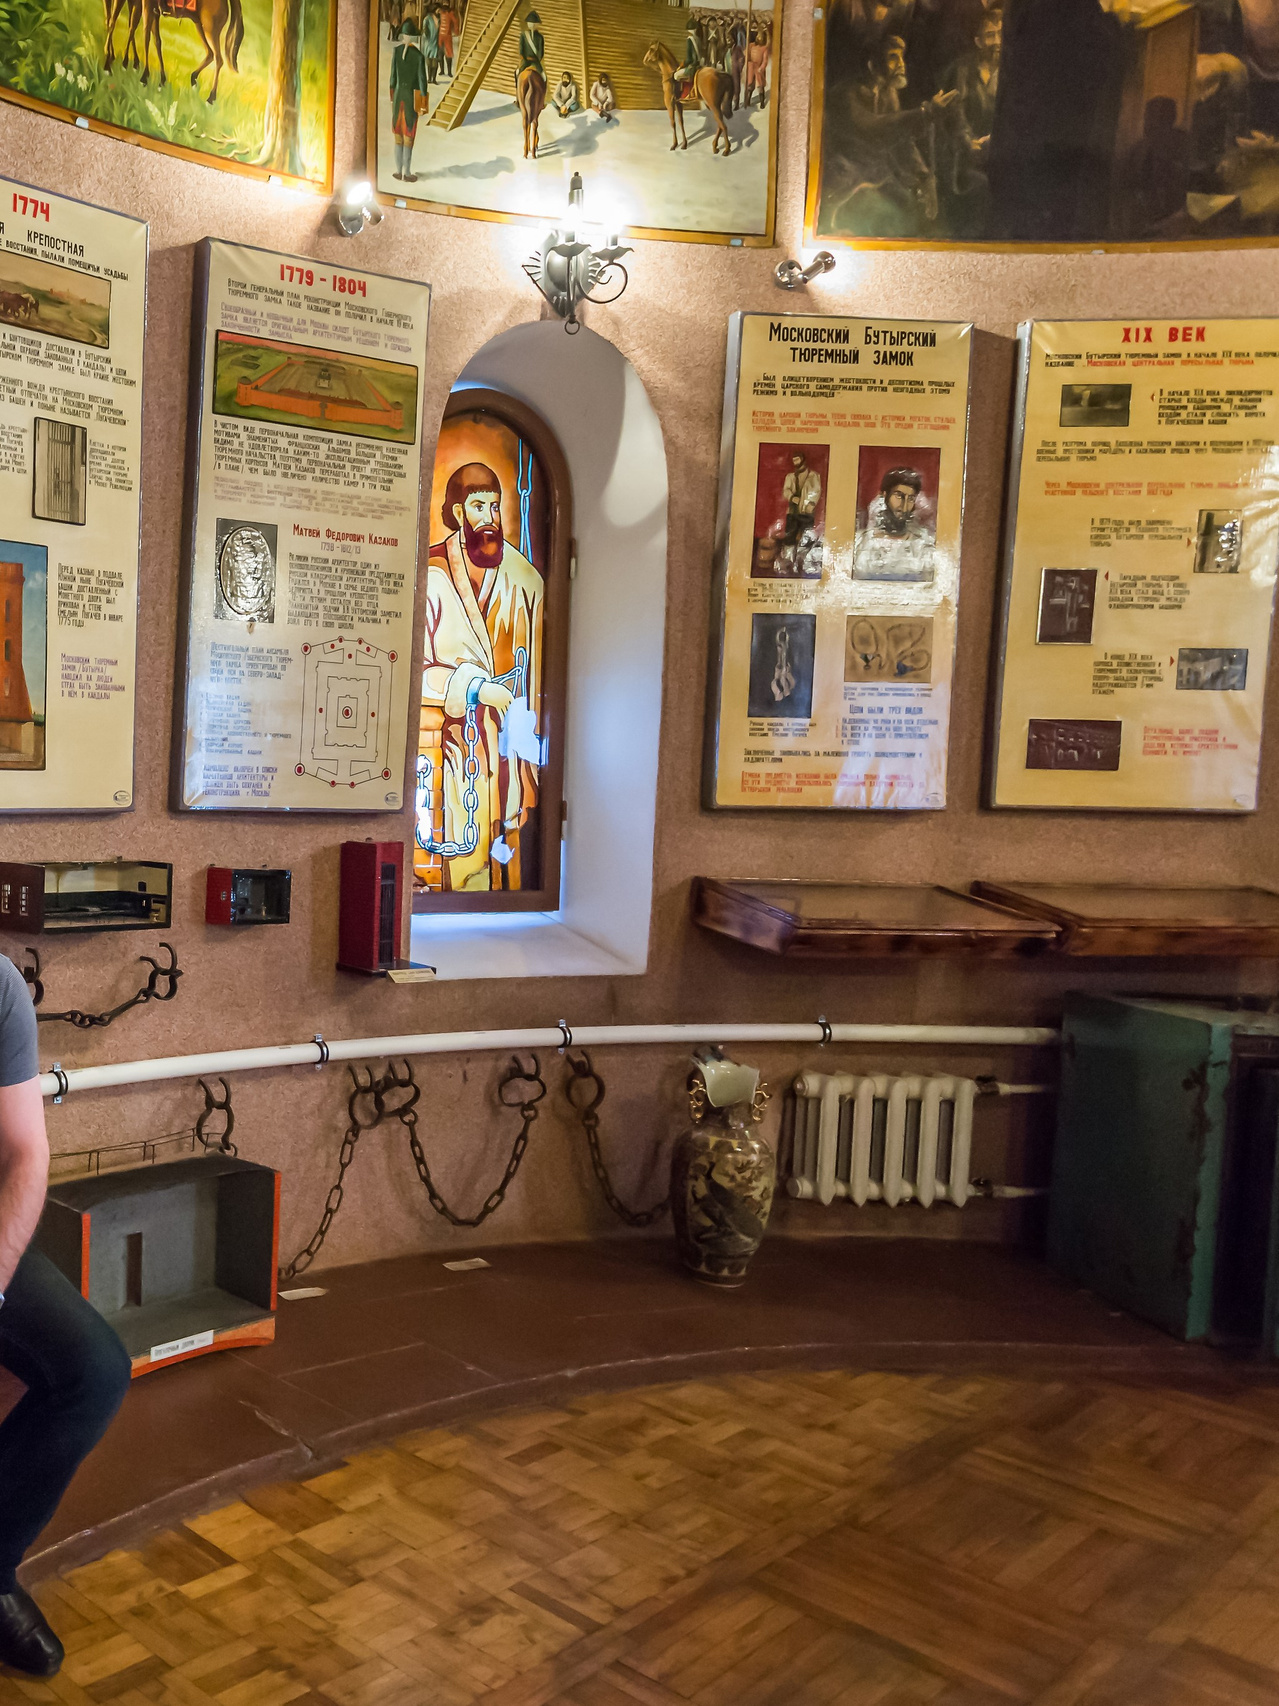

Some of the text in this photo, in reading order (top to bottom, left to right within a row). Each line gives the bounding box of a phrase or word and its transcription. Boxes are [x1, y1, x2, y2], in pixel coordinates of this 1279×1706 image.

[12, 193, 50, 222] 1774
[27, 228, 84, 258] КРЕПОСТНАЯ
[41, 249, 65, 264] ПЫЛАЛИ
[68, 257, 100, 274] ПОМЕЩИЧЬИ
[104, 267, 128, 282] УСАДЬБЫ
[279, 263, 314, 287] 1779
[333, 274, 367, 298] 1804
[769, 322, 936, 347] МОСКОВСКИЙ БУТЫРСКИЙ
[1121, 326, 1206, 342] XIX ВЕК
[790, 344, 914, 367] ТЮРЕМНЫЙ ЗАМОК
[293, 523, 399, 547] МАТВЕЙ ФЕДОРОВИЧ КАЗАКОВ
